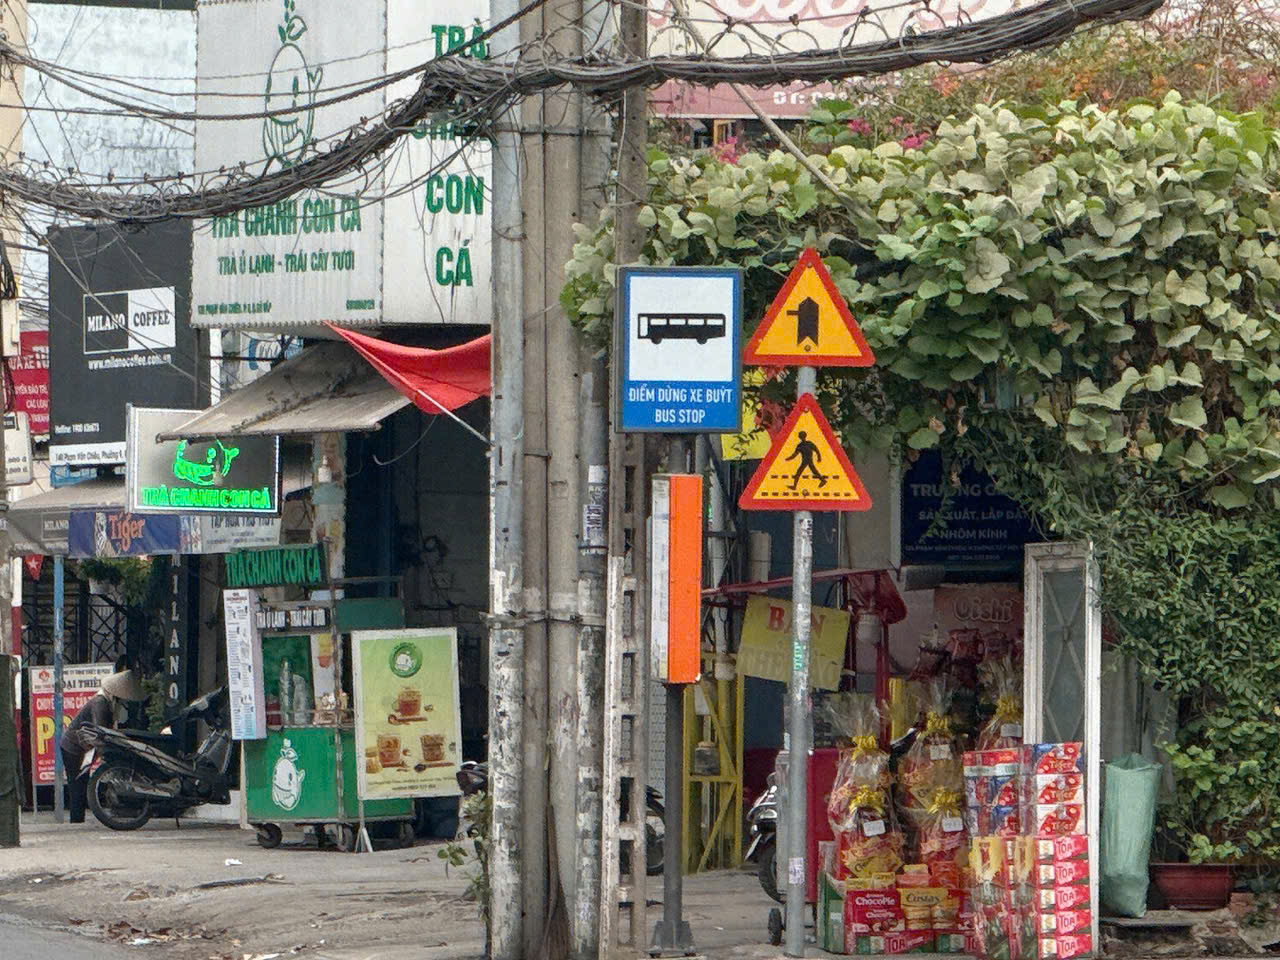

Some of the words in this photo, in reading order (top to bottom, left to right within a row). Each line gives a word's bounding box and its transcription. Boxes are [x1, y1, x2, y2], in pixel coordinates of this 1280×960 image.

[426, 175, 484, 215] CON
[303, 199, 336, 233] CON
[217, 251, 237, 275] TRÀ
[249, 254, 274, 277] LẠNH
[285, 251, 307, 272] TRÁI
[311, 248, 329, 272] CÂY
[435, 239, 473, 287] CÁ
[87, 313, 126, 332] MILANO
[133, 311, 170, 327] COFFEE
[628, 383, 655, 402] ĐIỂM
[658, 385, 687, 402] DỪNG
[690, 388, 703, 402] XE
[706, 386, 733, 403] BUÝT
[655, 409, 676, 423] BUS
[679, 409, 705, 423] STOP
[221, 489, 250, 508] CON
[108, 512, 145, 551] Tiger
